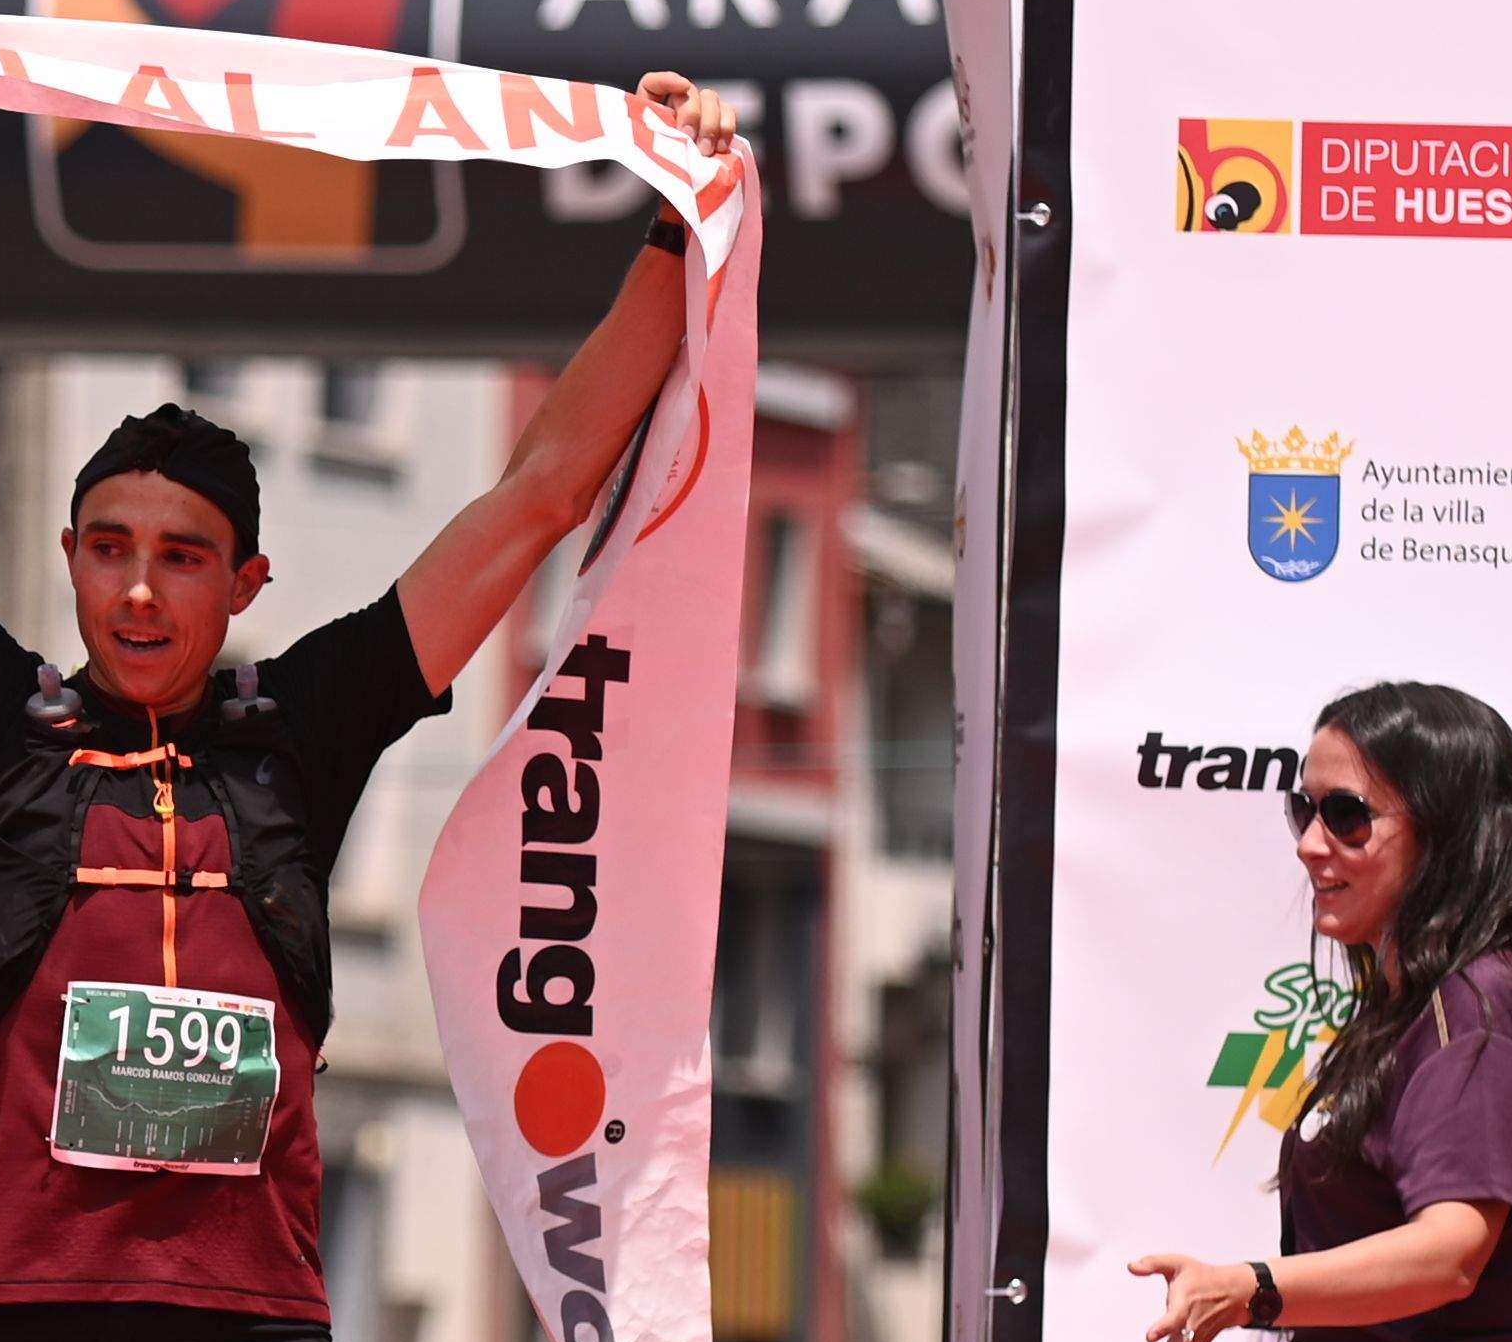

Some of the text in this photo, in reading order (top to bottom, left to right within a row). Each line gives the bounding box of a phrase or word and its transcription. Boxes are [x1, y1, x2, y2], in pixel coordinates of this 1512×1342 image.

[1320, 185, 1375, 222] DE
[1361, 499, 1486, 526] de la villa
[1361, 537, 1394, 563] de
[108, 1005, 242, 1071] 1599
[111, 1065, 151, 1080] MARCOS
[152, 1068, 185, 1083] RAMOS
